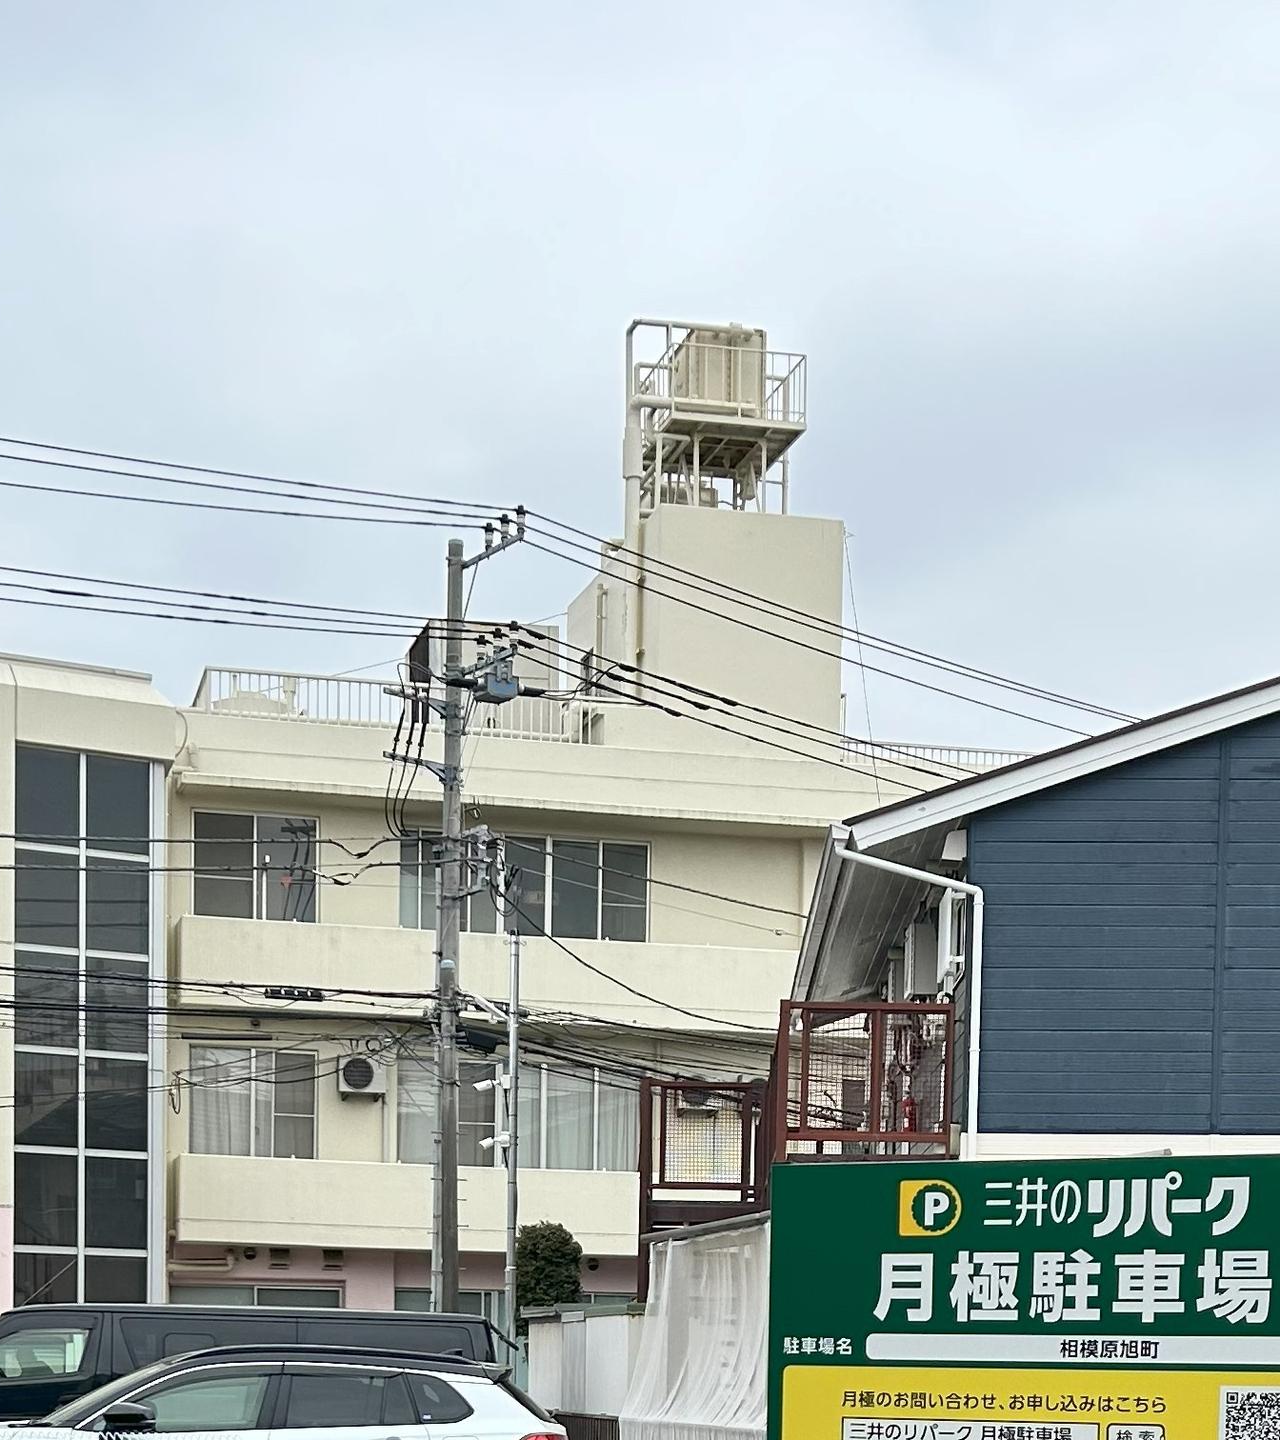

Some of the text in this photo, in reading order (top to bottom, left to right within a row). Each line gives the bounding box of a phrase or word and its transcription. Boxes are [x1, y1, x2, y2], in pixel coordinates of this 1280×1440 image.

[984, 1171, 1251, 1238] 三井のリパーク
[873, 1249, 1273, 1324] 月極駐車場
[783, 1336, 853, 1356] 駐車場名
[1060, 1339, 1159, 1360] 相模原旭町
[841, 1390, 1167, 1414] 月極のお問い合わせ、お申し込みはこちら
